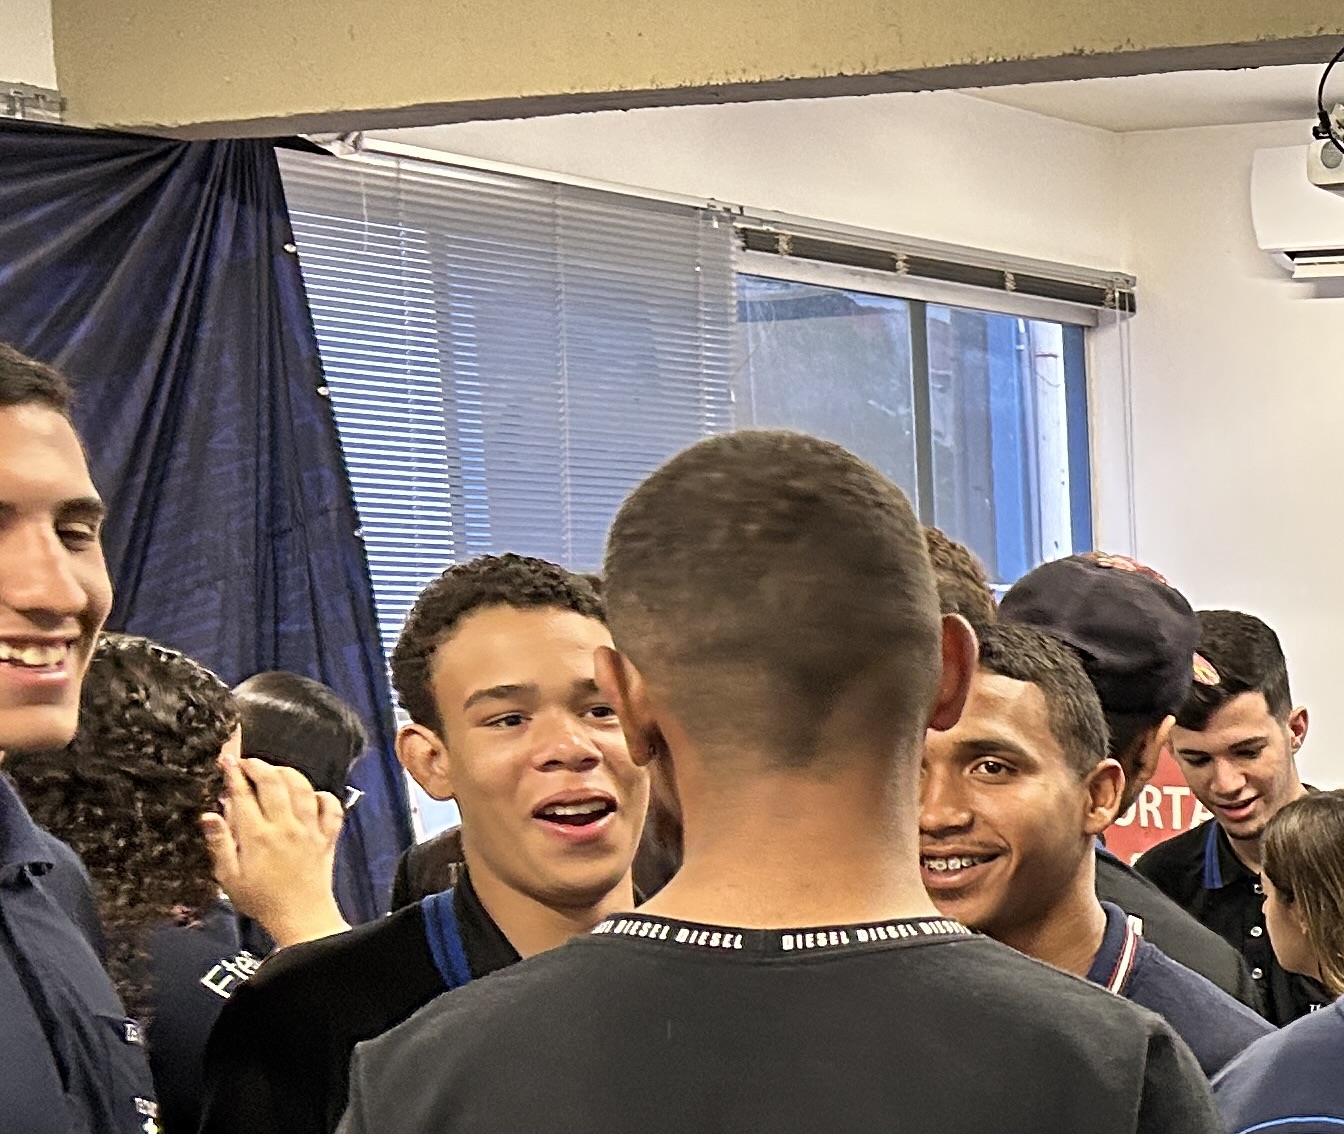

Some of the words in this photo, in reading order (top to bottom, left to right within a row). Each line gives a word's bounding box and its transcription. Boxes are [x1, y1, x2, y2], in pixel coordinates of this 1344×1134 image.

[613, 919, 671, 940] DIESEL
[674, 929, 743, 950] DIESEL
[781, 930, 850, 951] DIESEL
[856, 923, 918, 942] DIESEL
